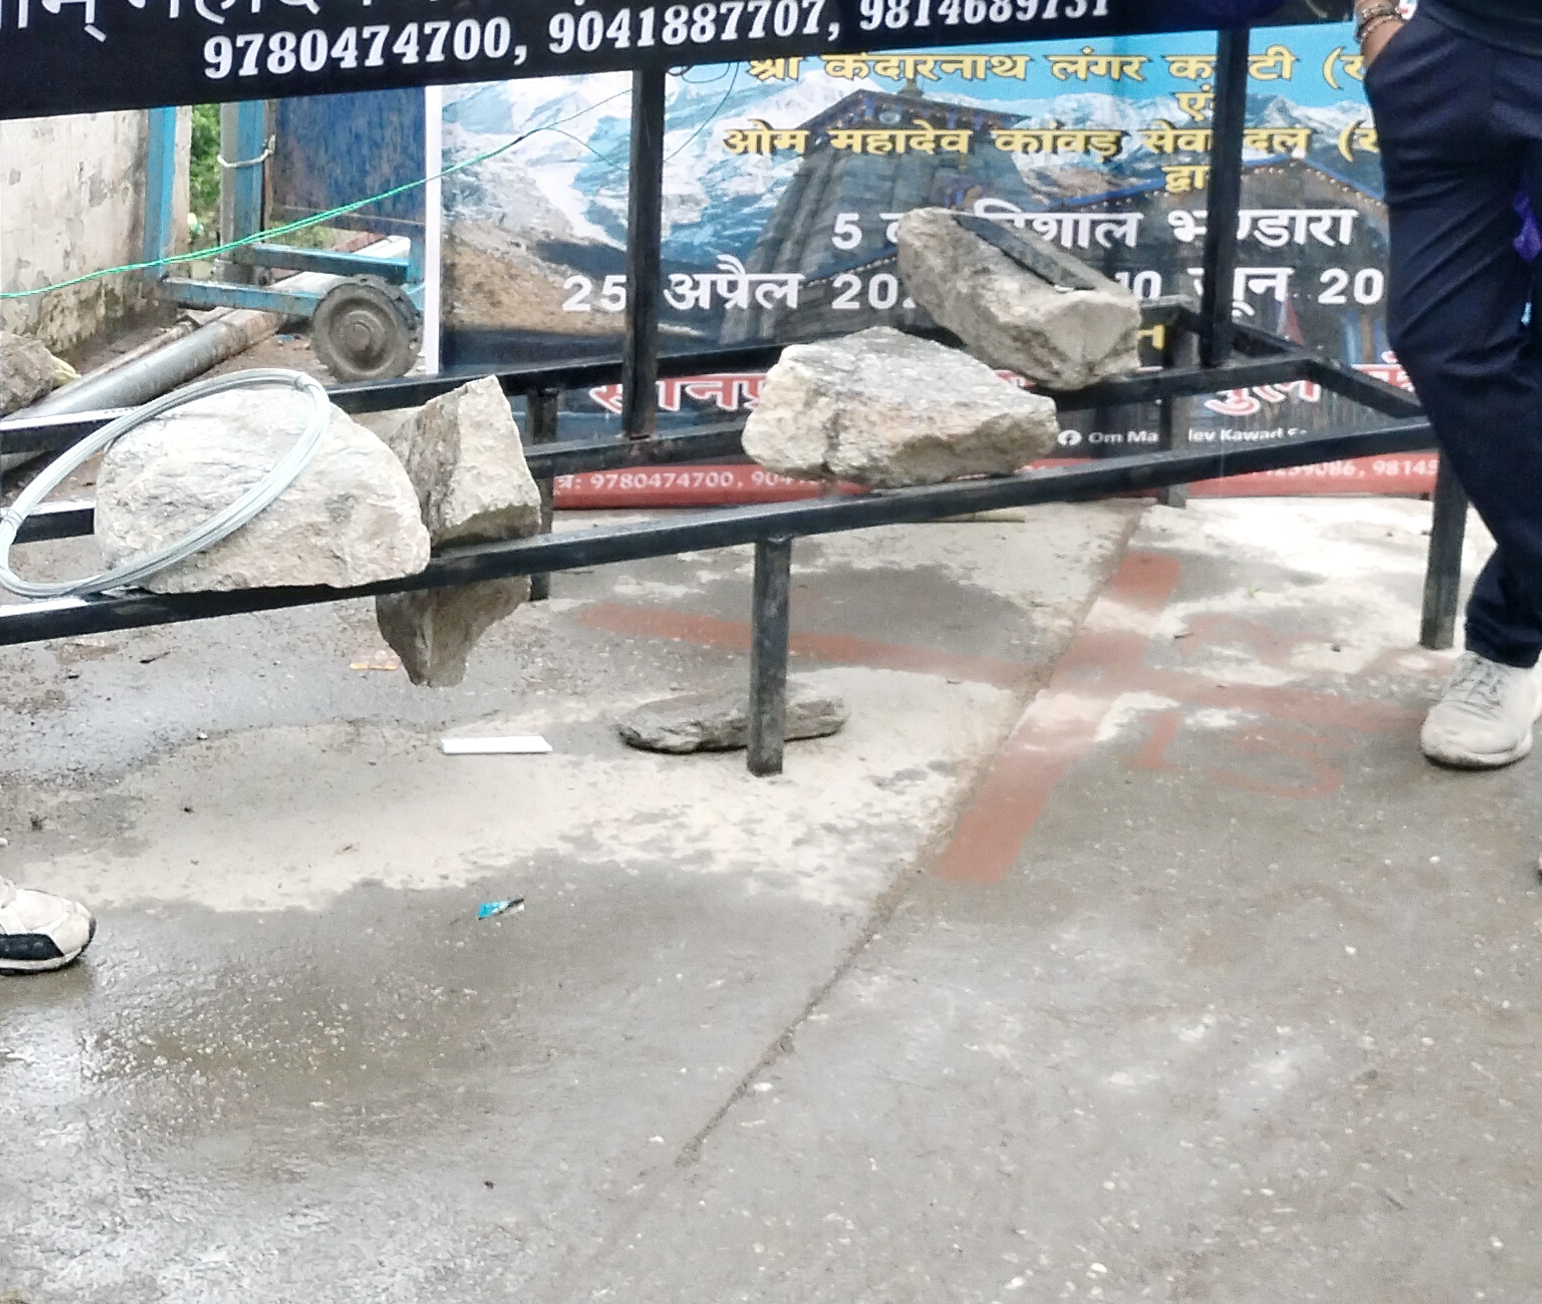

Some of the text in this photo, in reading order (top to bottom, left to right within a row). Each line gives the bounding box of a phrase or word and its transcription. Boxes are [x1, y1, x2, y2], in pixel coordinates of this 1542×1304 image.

[202, 15, 529, 80] 9780474700,
[1044, 46, 1151, 82] लंगर
[722, 118, 811, 155] ओम
[826, 118, 975, 155] महादेव
[989, 121, 1128, 164] कांवड़
[830, 212, 863, 250] 5
[562, 274, 628, 314] 25
[663, 254, 806, 314] अप्रैल
[831, 273, 915, 311] 20
[1317, 267, 1385, 306] 20
[1087, 430, 1123, 444] Om
